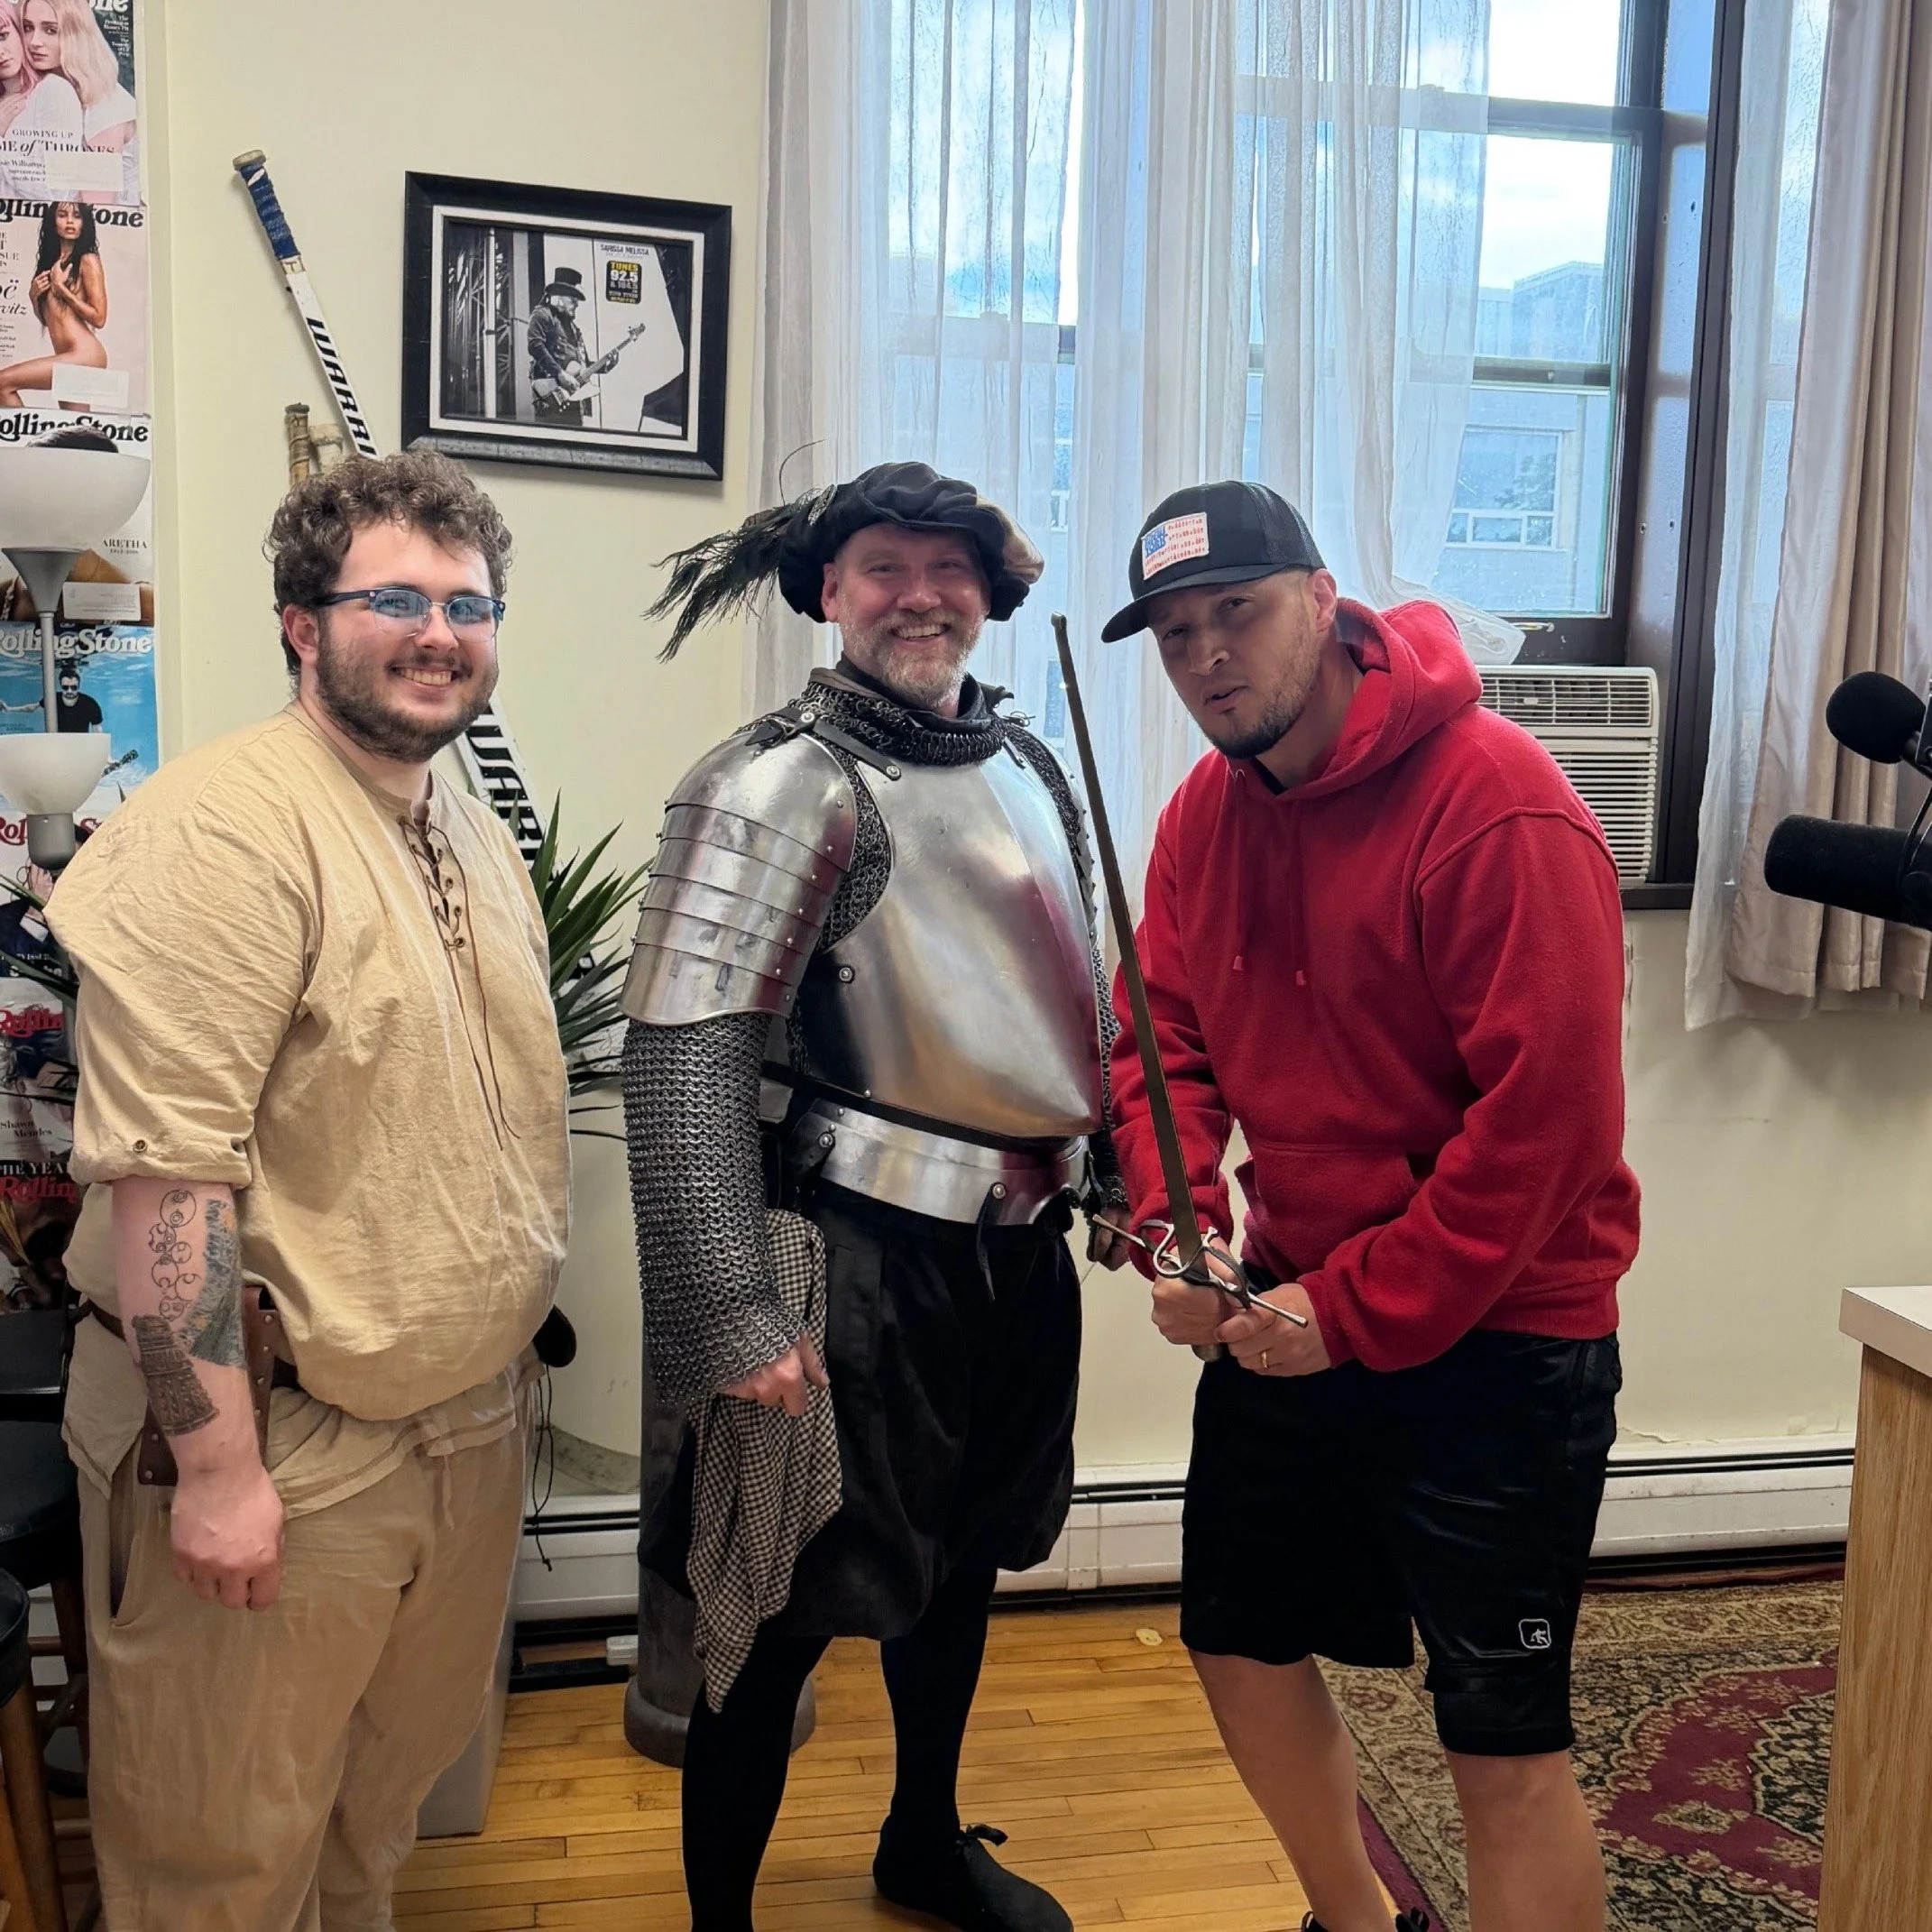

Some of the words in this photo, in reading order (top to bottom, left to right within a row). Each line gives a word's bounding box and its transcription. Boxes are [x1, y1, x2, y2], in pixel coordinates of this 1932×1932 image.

[12, 129, 59, 138] GROWING
[0, 199, 49, 223] ollin
[611, 262, 639, 271] TUNES
[610, 270, 639, 282] 92.5
[77, 628, 152, 653] Stone
